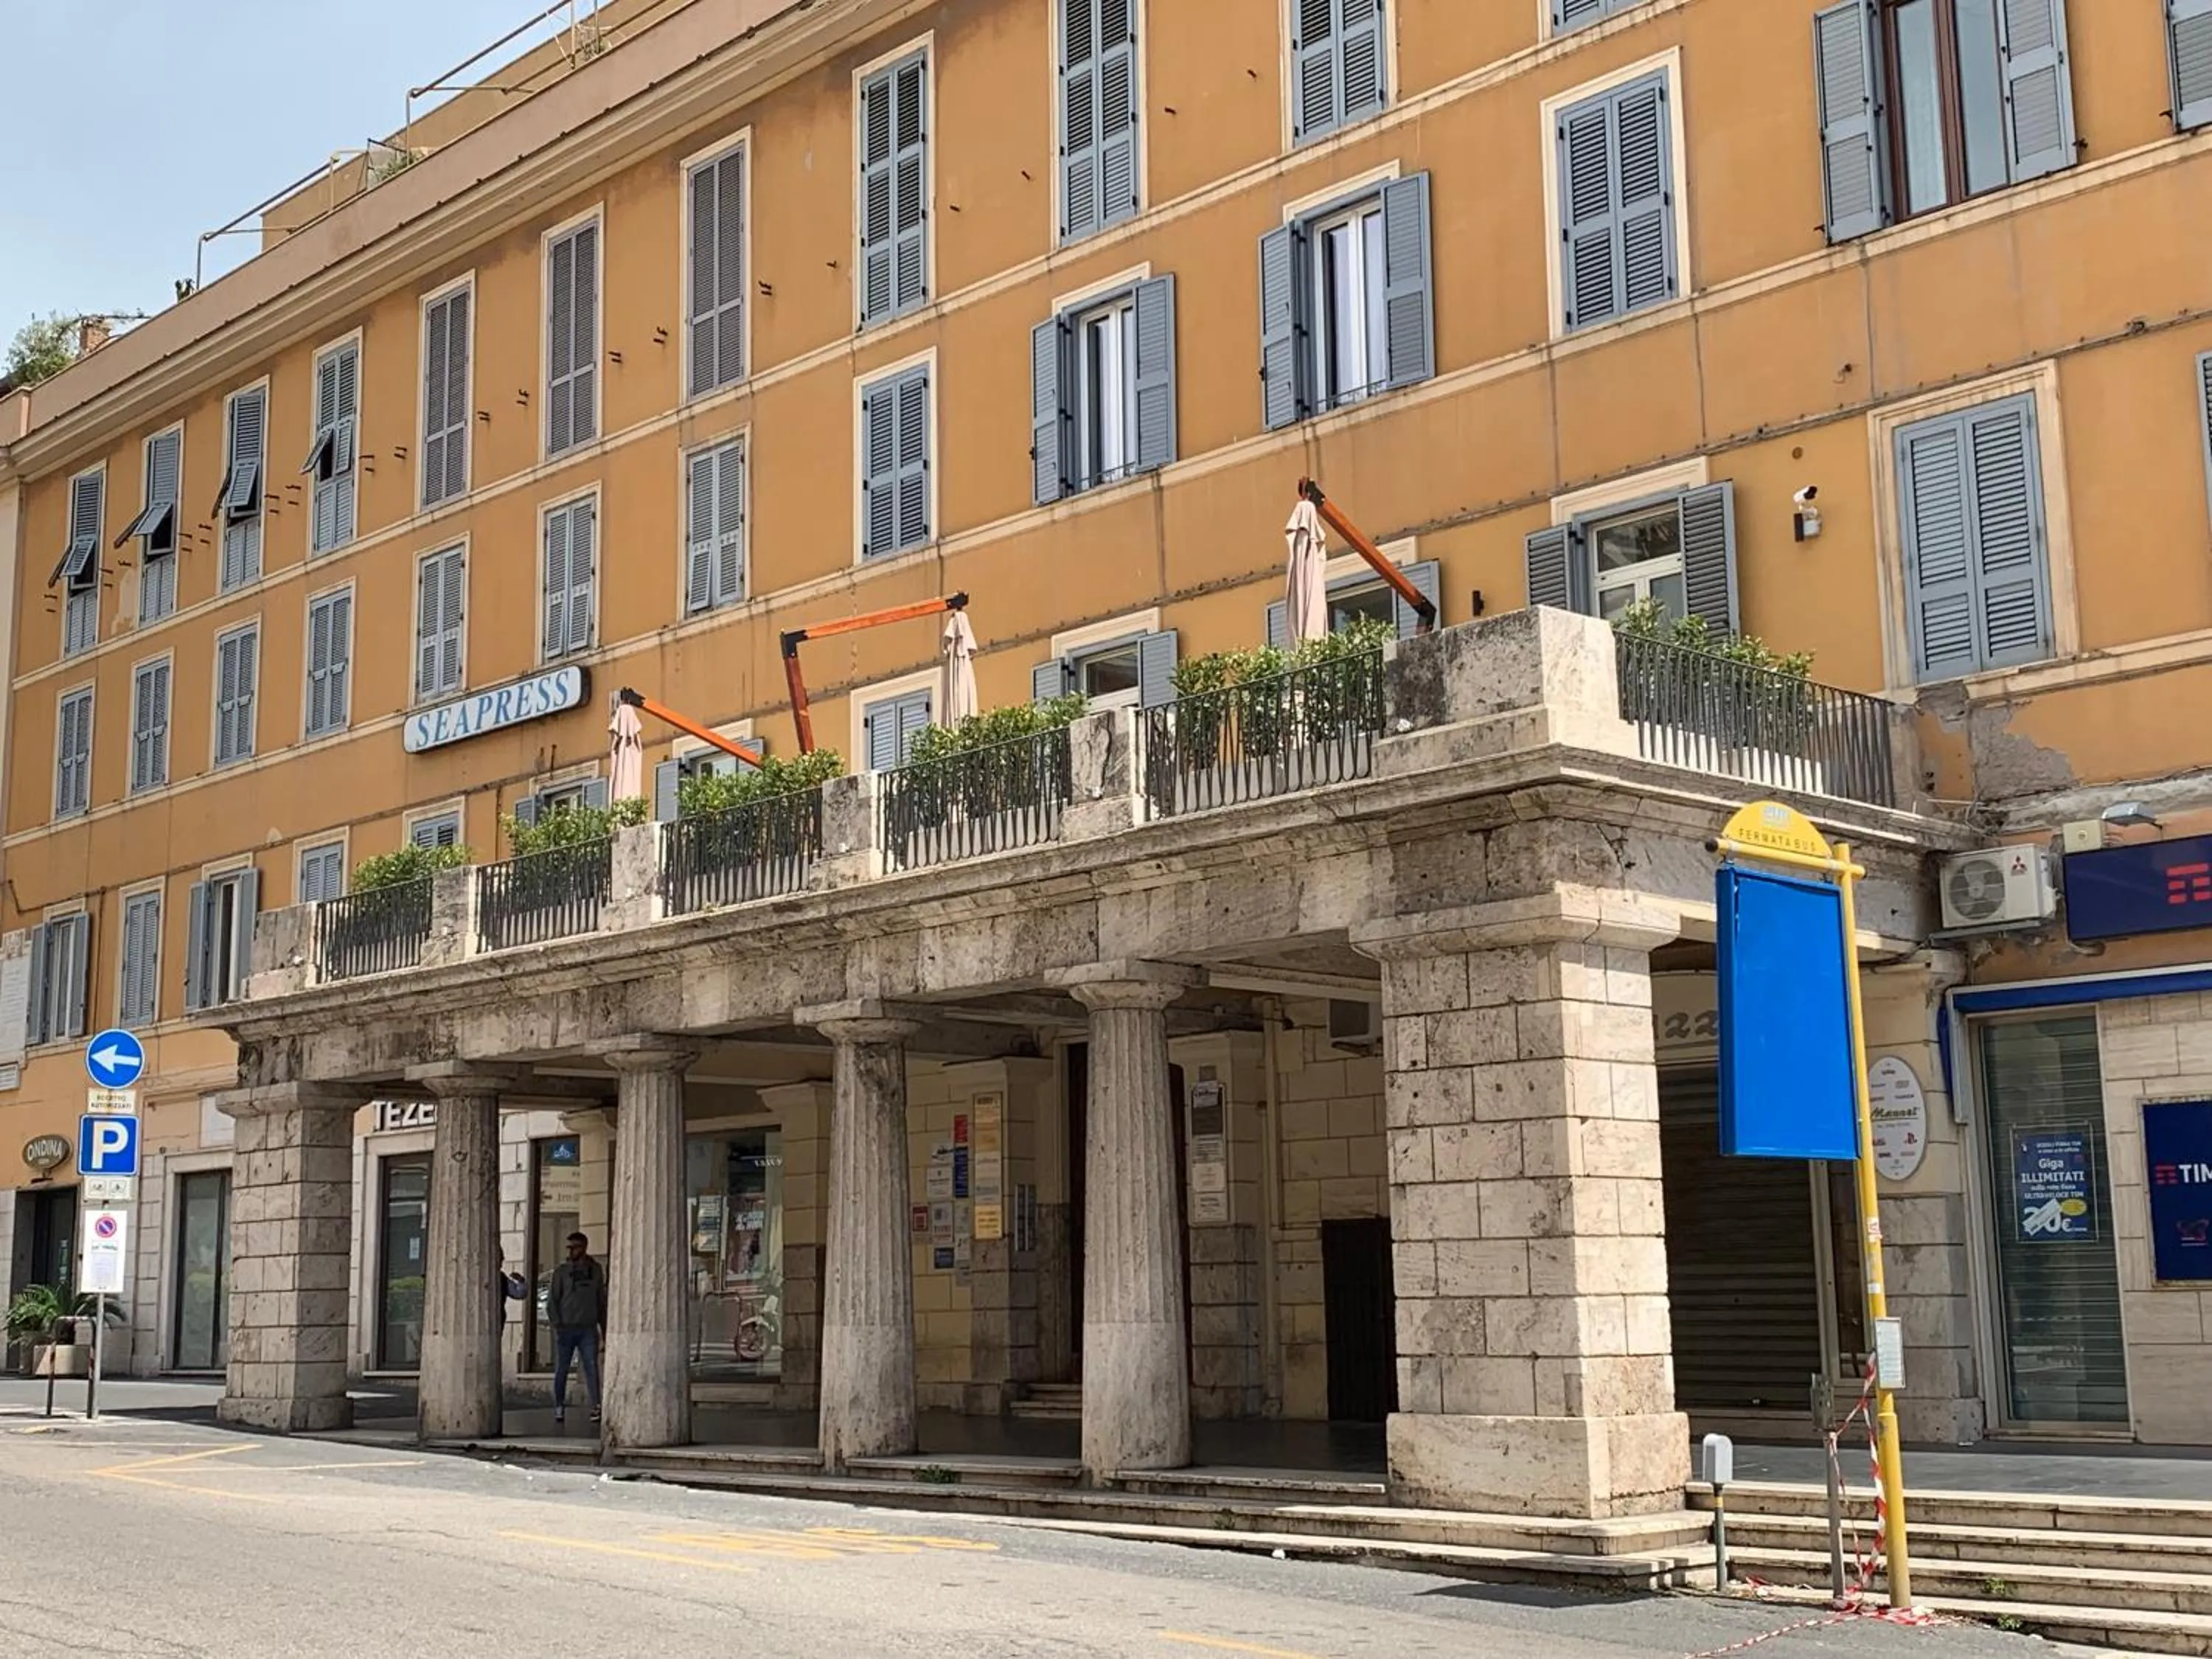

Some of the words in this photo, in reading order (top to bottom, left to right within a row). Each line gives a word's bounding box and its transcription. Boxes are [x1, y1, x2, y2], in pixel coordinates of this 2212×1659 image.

[415, 669, 569, 748] SEAPRESS
[1738, 828, 1791, 846] FERMATA
[372, 1100, 438, 1131] TEZE
[27, 1138, 63, 1161] ONDINA
[91, 1121, 129, 1169] P
[2038, 1158, 2064, 1170] Giga
[2020, 1171, 2085, 1183] ILLIMITATI
